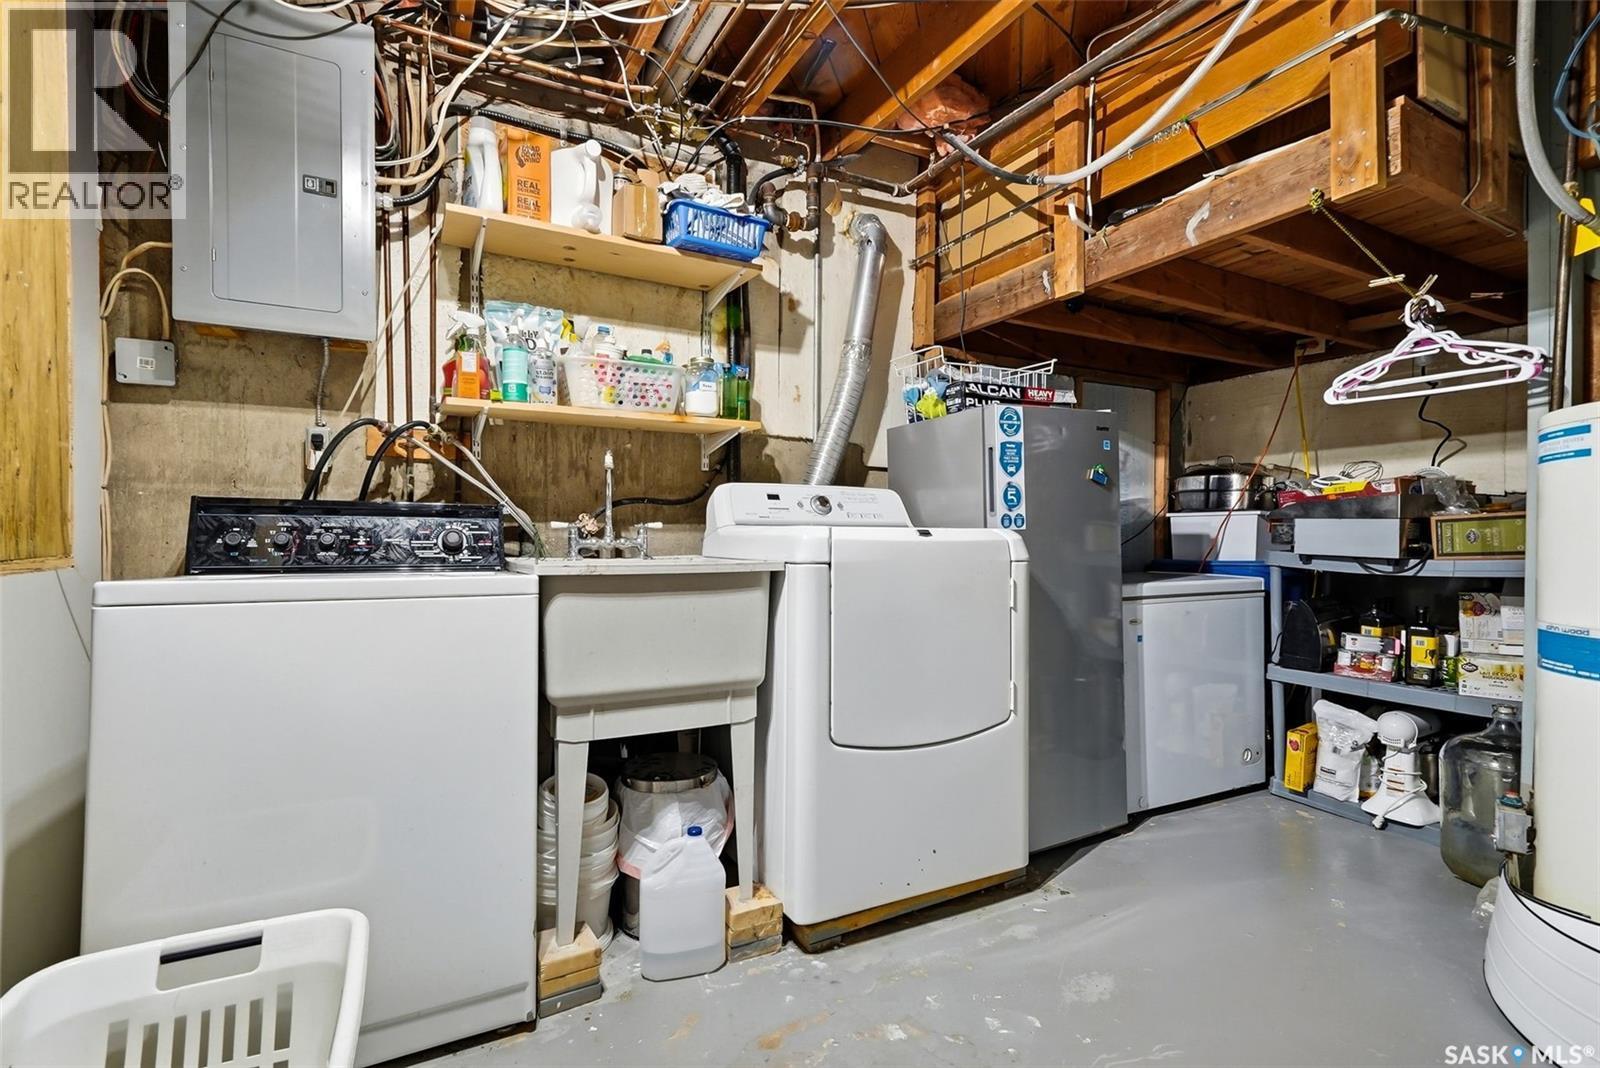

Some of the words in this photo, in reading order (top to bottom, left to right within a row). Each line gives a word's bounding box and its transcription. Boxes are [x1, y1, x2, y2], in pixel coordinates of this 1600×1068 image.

[517, 179, 540, 190] REAL
[517, 196, 541, 207] REAL
[965, 383, 1020, 399] ALCAN
[1028, 389, 1053, 399] HEAVY
[1007, 491, 1017, 503] 5
